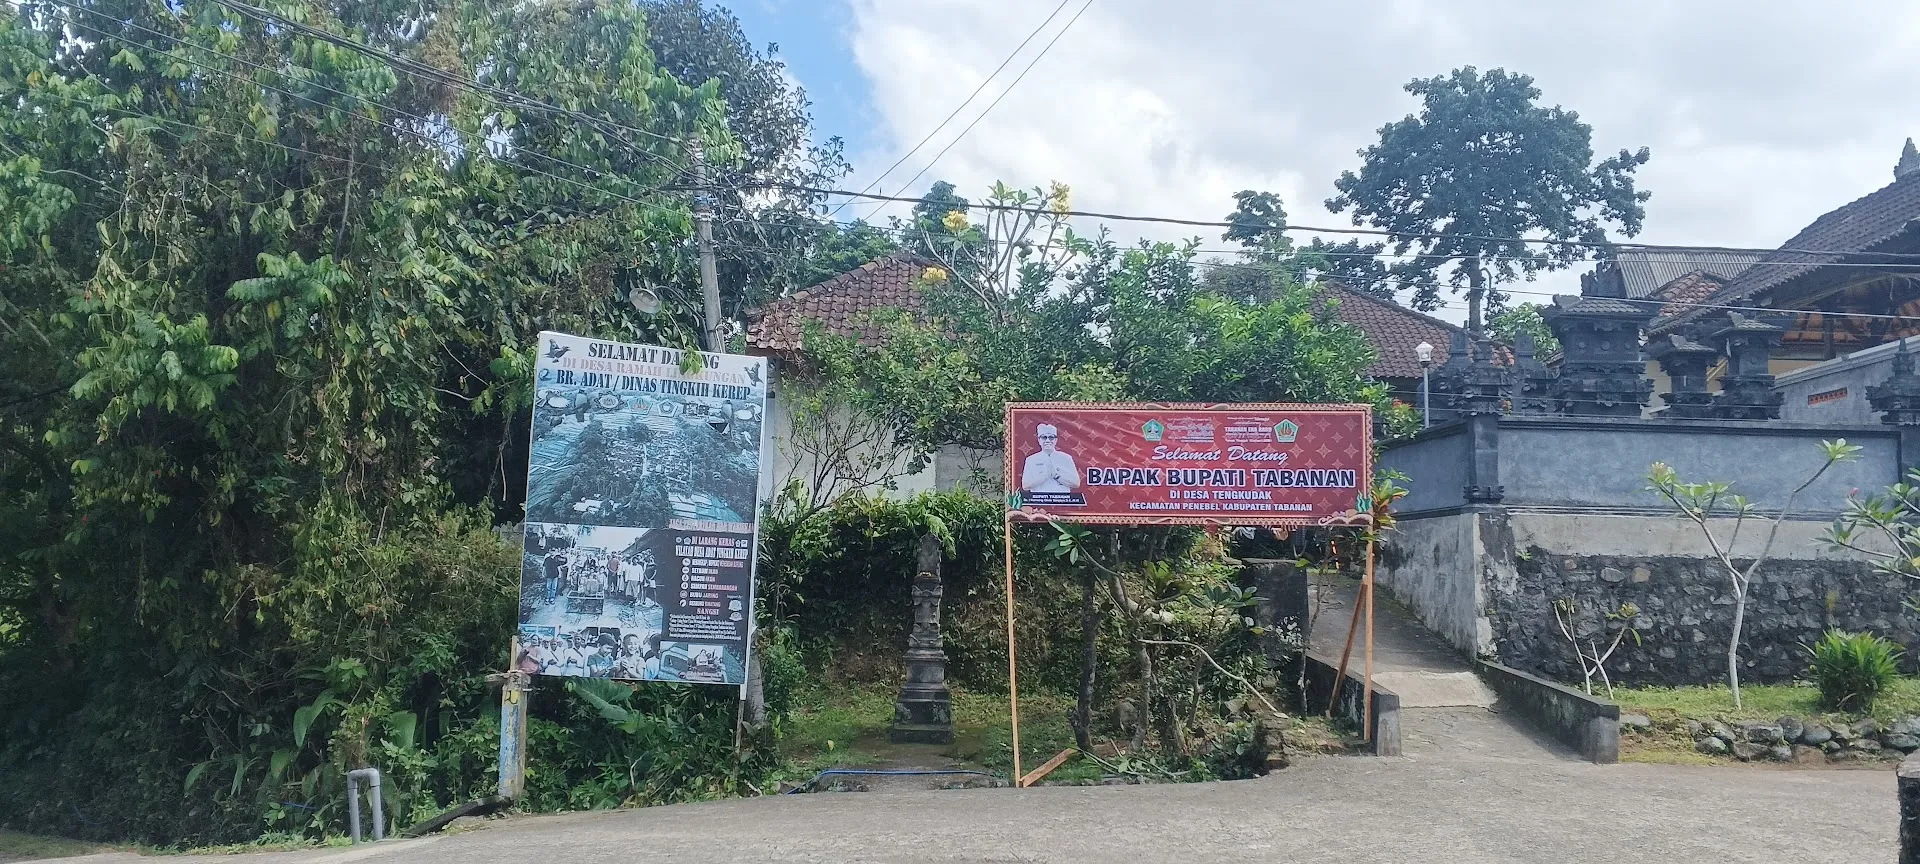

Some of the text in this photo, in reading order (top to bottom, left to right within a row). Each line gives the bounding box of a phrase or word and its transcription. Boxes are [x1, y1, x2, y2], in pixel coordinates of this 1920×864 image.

[588, 342, 719, 369] SELAMAT DANG
[563, 357, 577, 368] DI
[580, 359, 613, 372] DESA
[617, 362, 663, 376] RAMAH
[556, 369, 751, 400] BR. ADAT / DINAS TINGKIH KEREP
[1152, 445, 1288, 466] Selamat Datang
[1087, 467, 1356, 489] BAPAK BUPATI TABANAN
[1170, 490, 1272, 500] DI DESA TENGKUDAK
[1130, 502, 1181, 510] KECAMATAN
[1182, 503, 1220, 511] PENEBEL
[1222, 503, 1271, 511] KABUPATEN
